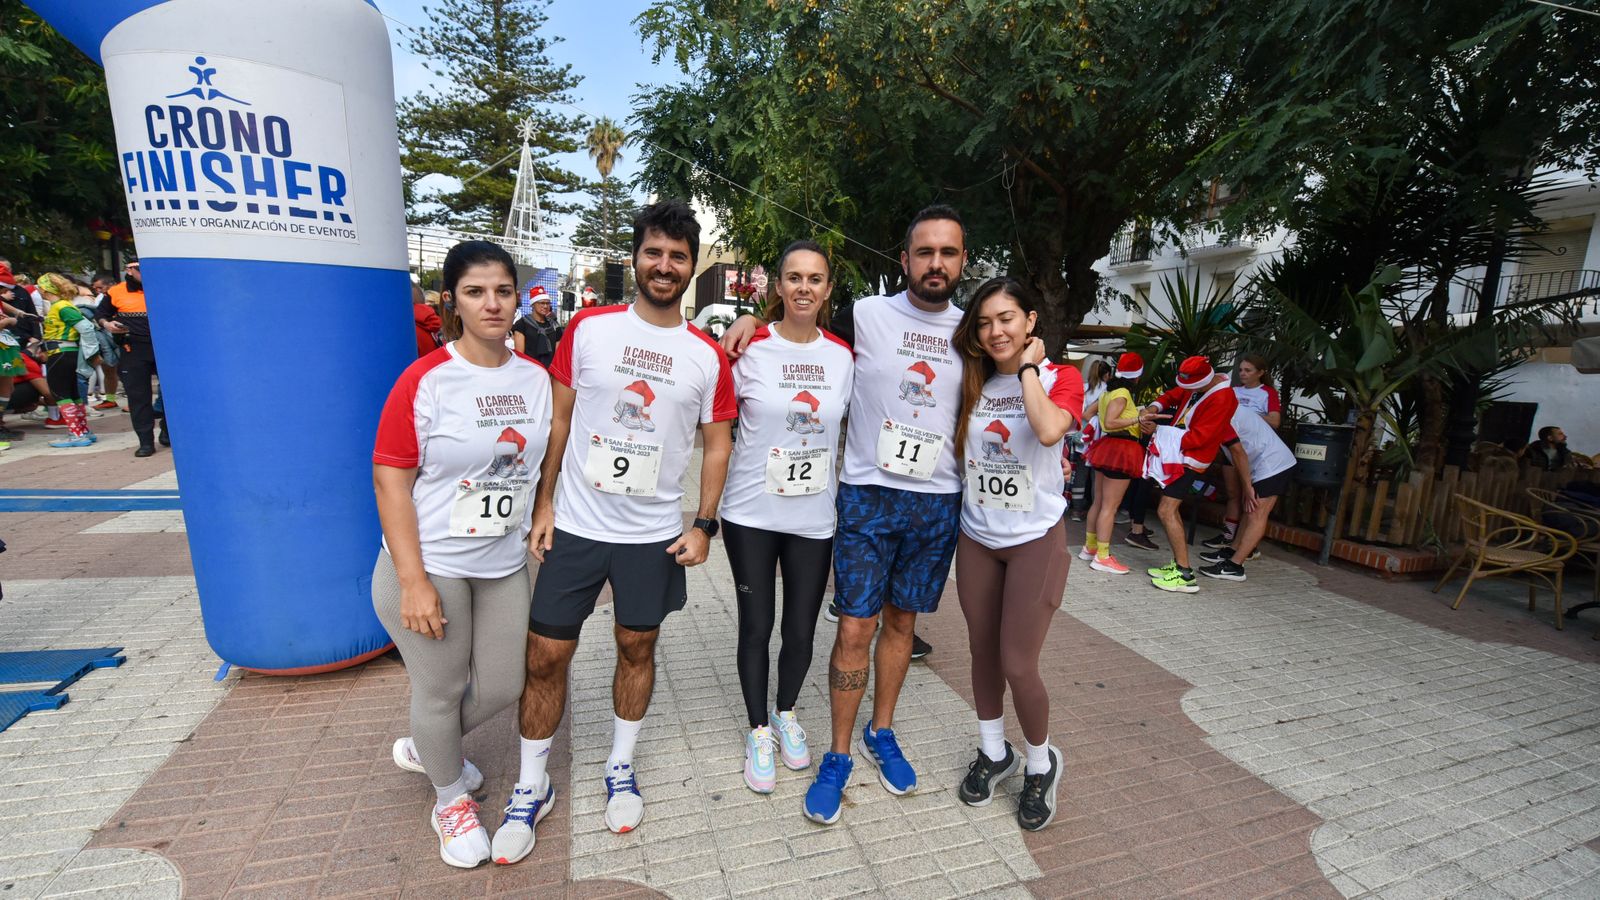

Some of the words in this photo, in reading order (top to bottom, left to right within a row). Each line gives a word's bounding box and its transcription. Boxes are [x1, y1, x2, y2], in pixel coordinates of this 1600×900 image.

[145, 104, 292, 158] CRONO
[122, 150, 353, 224] FINISHER
[190, 217, 196, 227] Y
[200, 217, 287, 232] ORGANIZACIÓN
[291, 223, 305, 233] DE
[309, 225, 356, 239] EVENTOS
[902, 340, 916, 349] SAN
[916, 343, 948, 356] SILVESTRE
[904, 332, 910, 340] II
[911, 332, 948, 348] CARRERA
[622, 356, 636, 366] SAN
[637, 360, 672, 375] SILVESTRE
[624, 346, 631, 356] II
[632, 348, 672, 367] CARRERA
[782, 364, 788, 373] II
[790, 364, 824, 374] CARRERA
[796, 374, 826, 382] SILVESTRE
[476, 397, 484, 408] II
[485, 395, 526, 407] CARRERA
[480, 408, 494, 417] SAN
[496, 406, 528, 416] SILVESTRE
[914, 430, 942, 440] SILVESTRE
[624, 442, 659, 452] SILVESTRE
[896, 440, 920, 462] 11
[613, 456, 630, 478] 9
[787, 462, 812, 481] 12
[978, 474, 1018, 496] 106
[480, 494, 512, 518] 10
